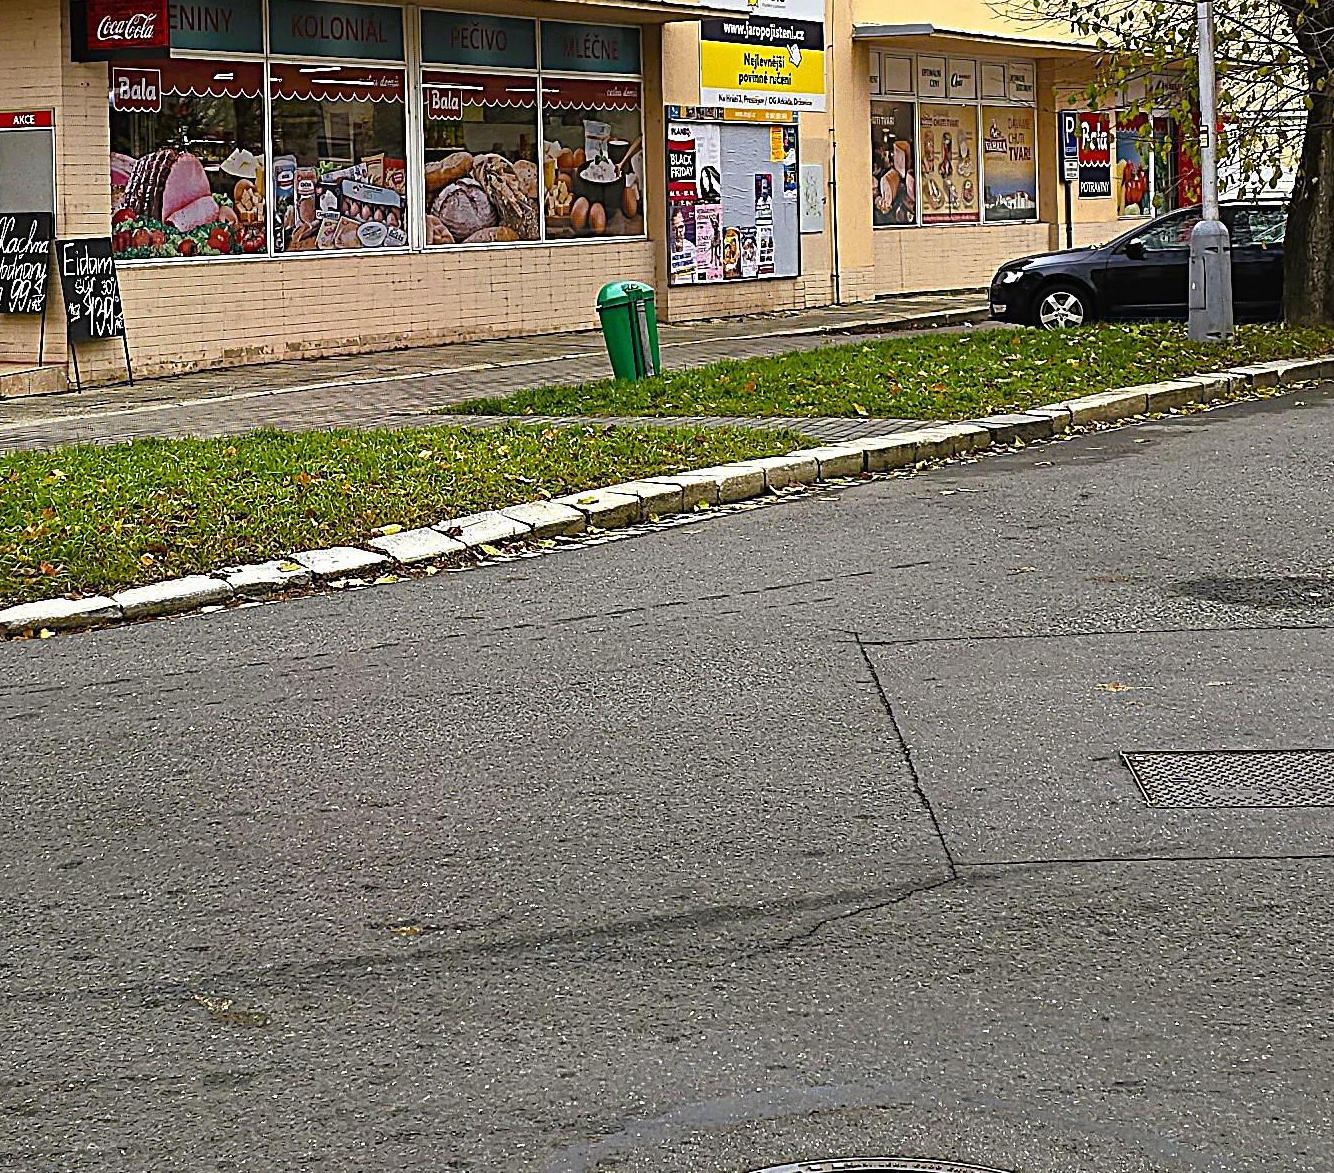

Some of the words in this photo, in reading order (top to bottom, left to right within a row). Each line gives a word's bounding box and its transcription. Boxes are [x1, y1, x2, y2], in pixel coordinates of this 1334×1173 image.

[97, 13, 157, 40] Coca-Cola
[291, 13, 387, 44] KOLONIÁL
[450, 21, 508, 51] PEČIVO
[743, 53, 785, 71] Nejlevnější
[119, 76, 157, 100] Bala
[432, 90, 459, 110] Bala
[13, 114, 35, 125] AKCE
[1065, 117, 1074, 144] P
[670, 153, 692, 165] BLACK
[671, 166, 693, 179] FRIDAY
[1080, 181, 1109, 194] POTRAVINY
[63, 242, 112, 276] Eidam
